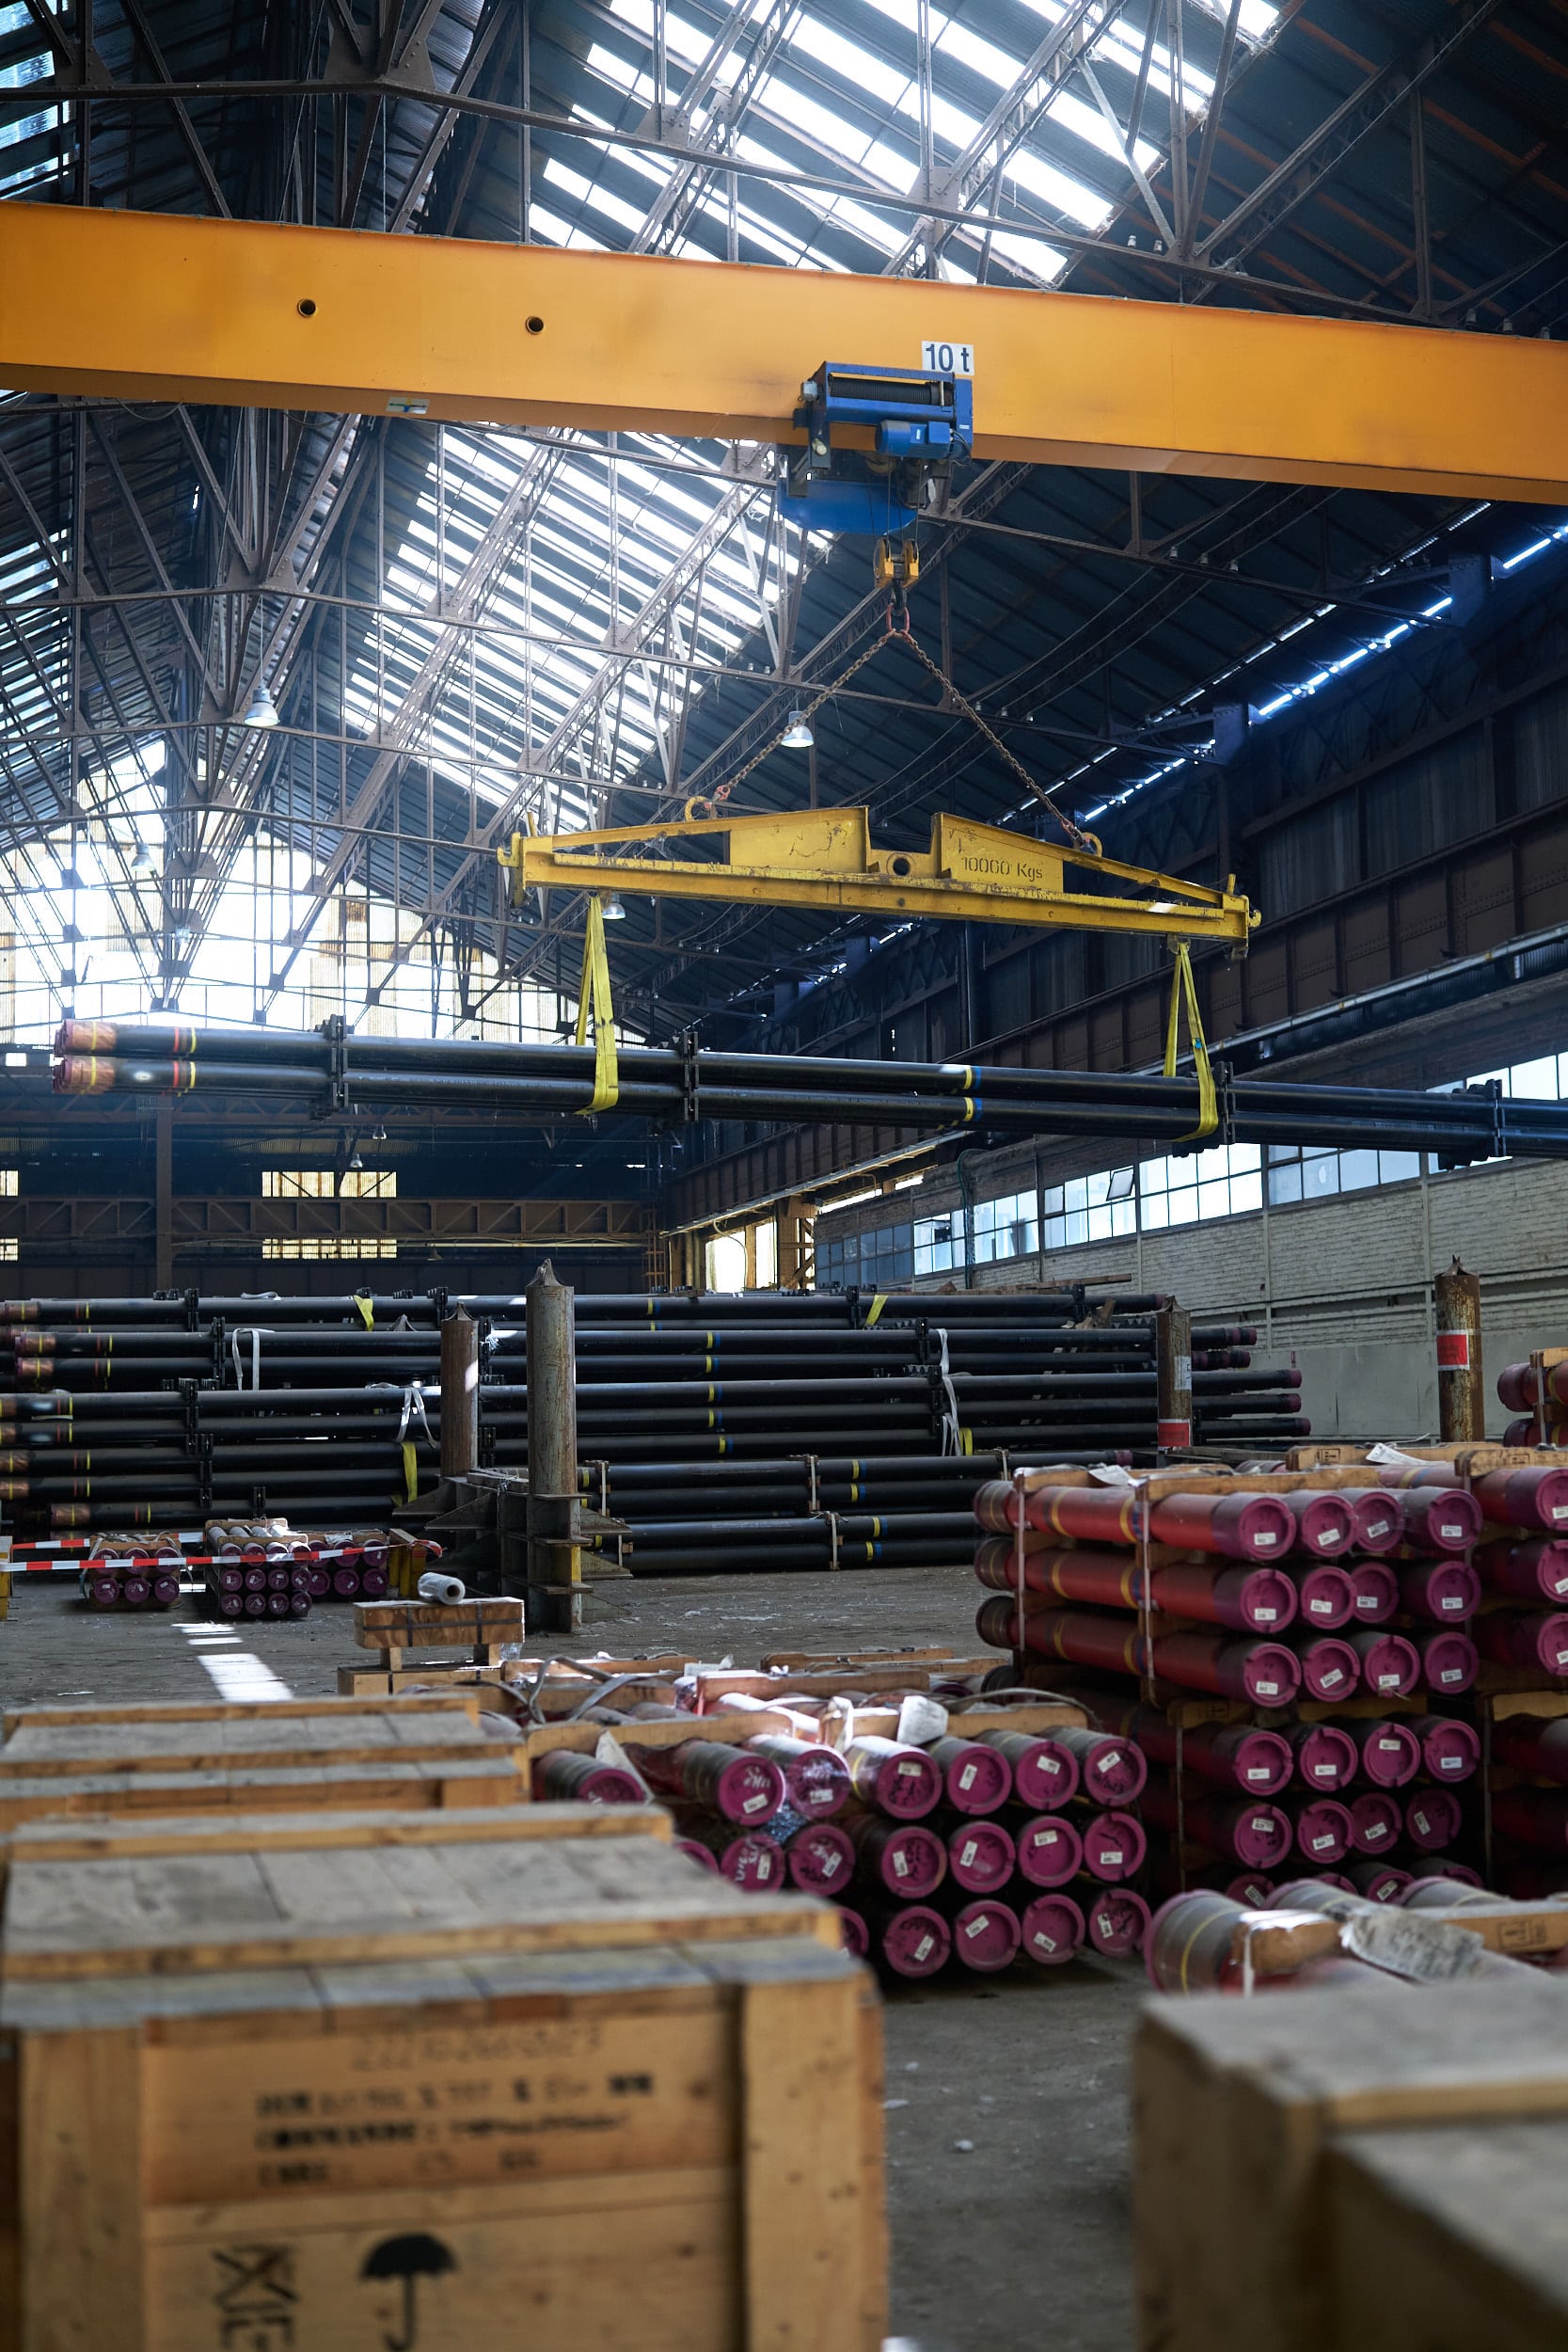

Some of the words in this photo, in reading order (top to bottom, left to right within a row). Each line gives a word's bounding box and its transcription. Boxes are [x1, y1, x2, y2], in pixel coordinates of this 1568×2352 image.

[926, 343, 954, 372] 10
[960, 347, 970, 373] t
[961, 856, 1011, 876] 10000
[1017, 862, 1043, 882] Kgs
